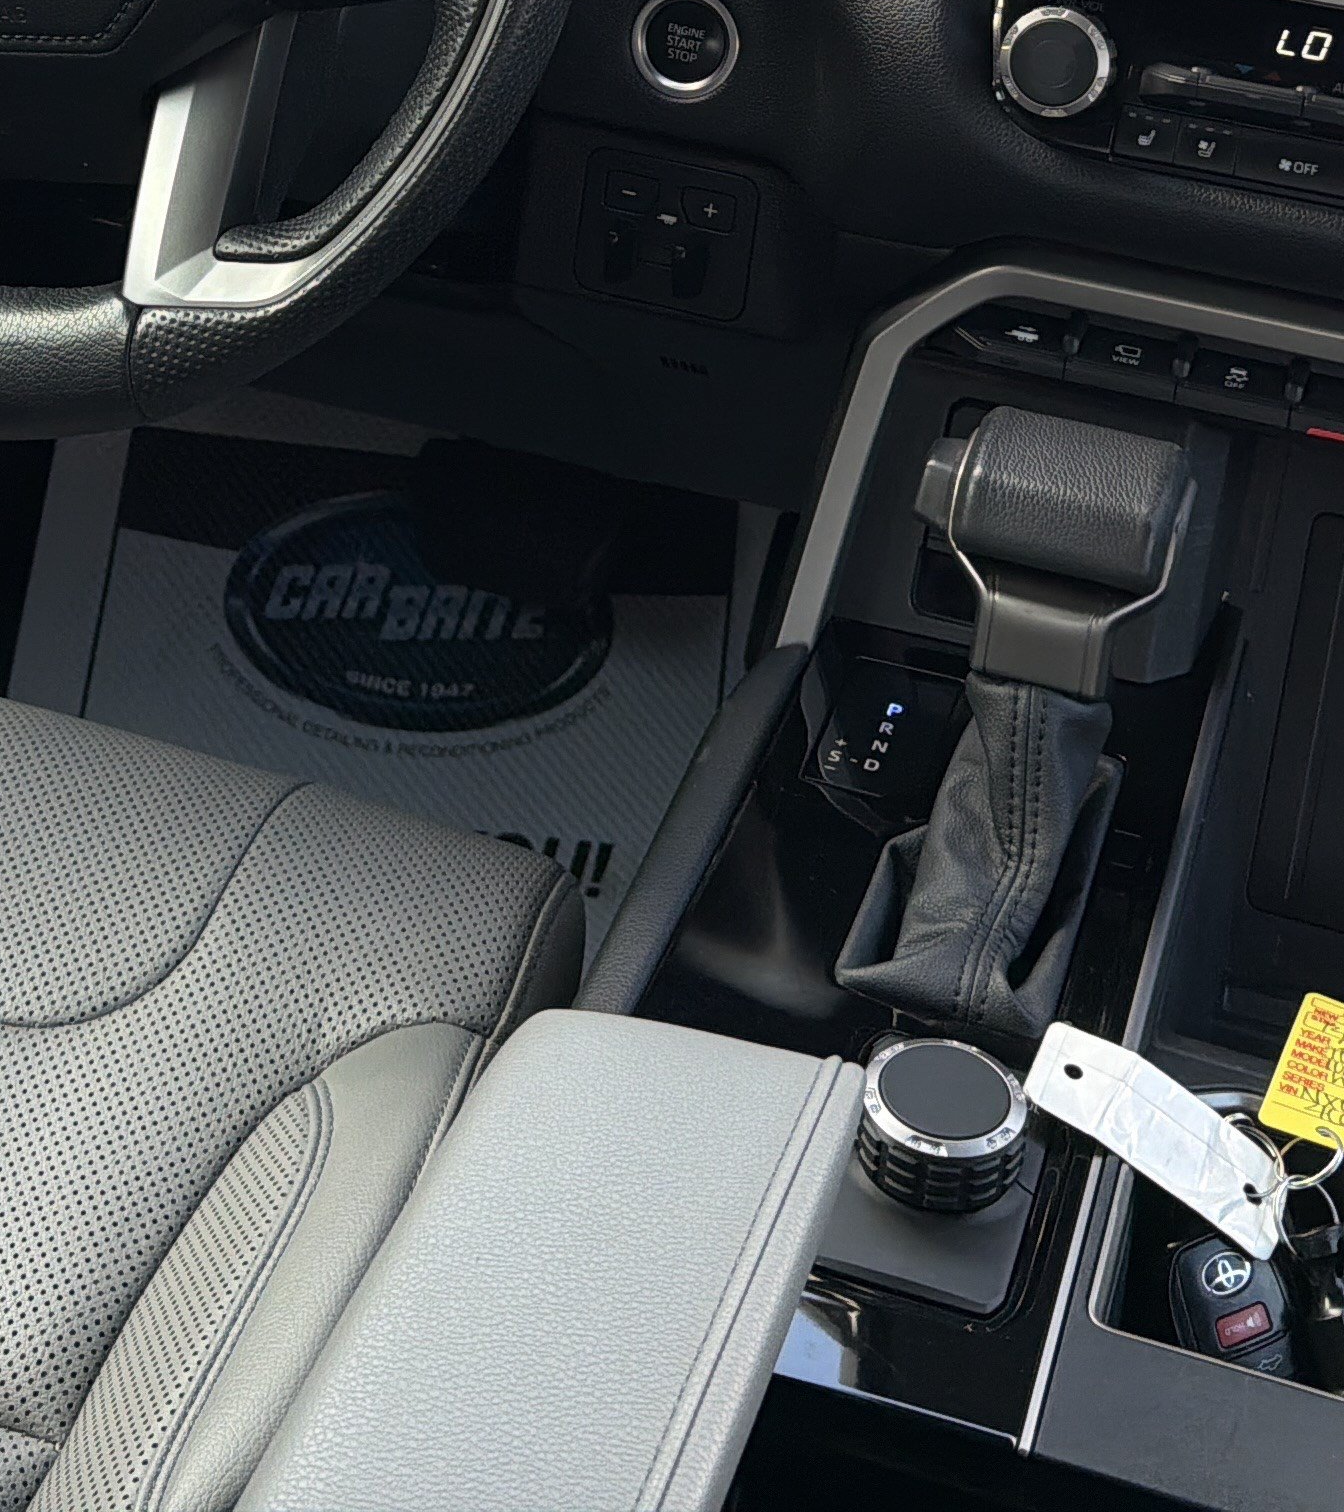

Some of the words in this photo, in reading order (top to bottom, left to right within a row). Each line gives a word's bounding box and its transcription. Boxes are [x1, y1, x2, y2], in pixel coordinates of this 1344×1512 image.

[667, 22, 706, 39] ENGINE
[666, 35, 702, 52] START
[667, 48, 698, 64] STOP
[1293, 161, 1319, 176] OFF
[1112, 354, 1140, 366] VIEW
[1224, 380, 1245, 390] OFF
[265, 561, 391, 621] CAR
[380, 583, 547, 642] BRITE
[345, 670, 412, 698] SINCE
[886, 702, 903, 717] P
[878, 721, 895, 736] R
[870, 739, 889, 754] N
[827, 749, 843, 763] S
[863, 758, 880, 772] D
[1299, 1028, 1331, 1045] YEAR
[1295, 1038, 1327, 1055] MAKE
[1287, 1060, 1328, 1080] COLOR
[1279, 1082, 1298, 1096] VIN
[1282, 1071, 1325, 1092] SERIES
